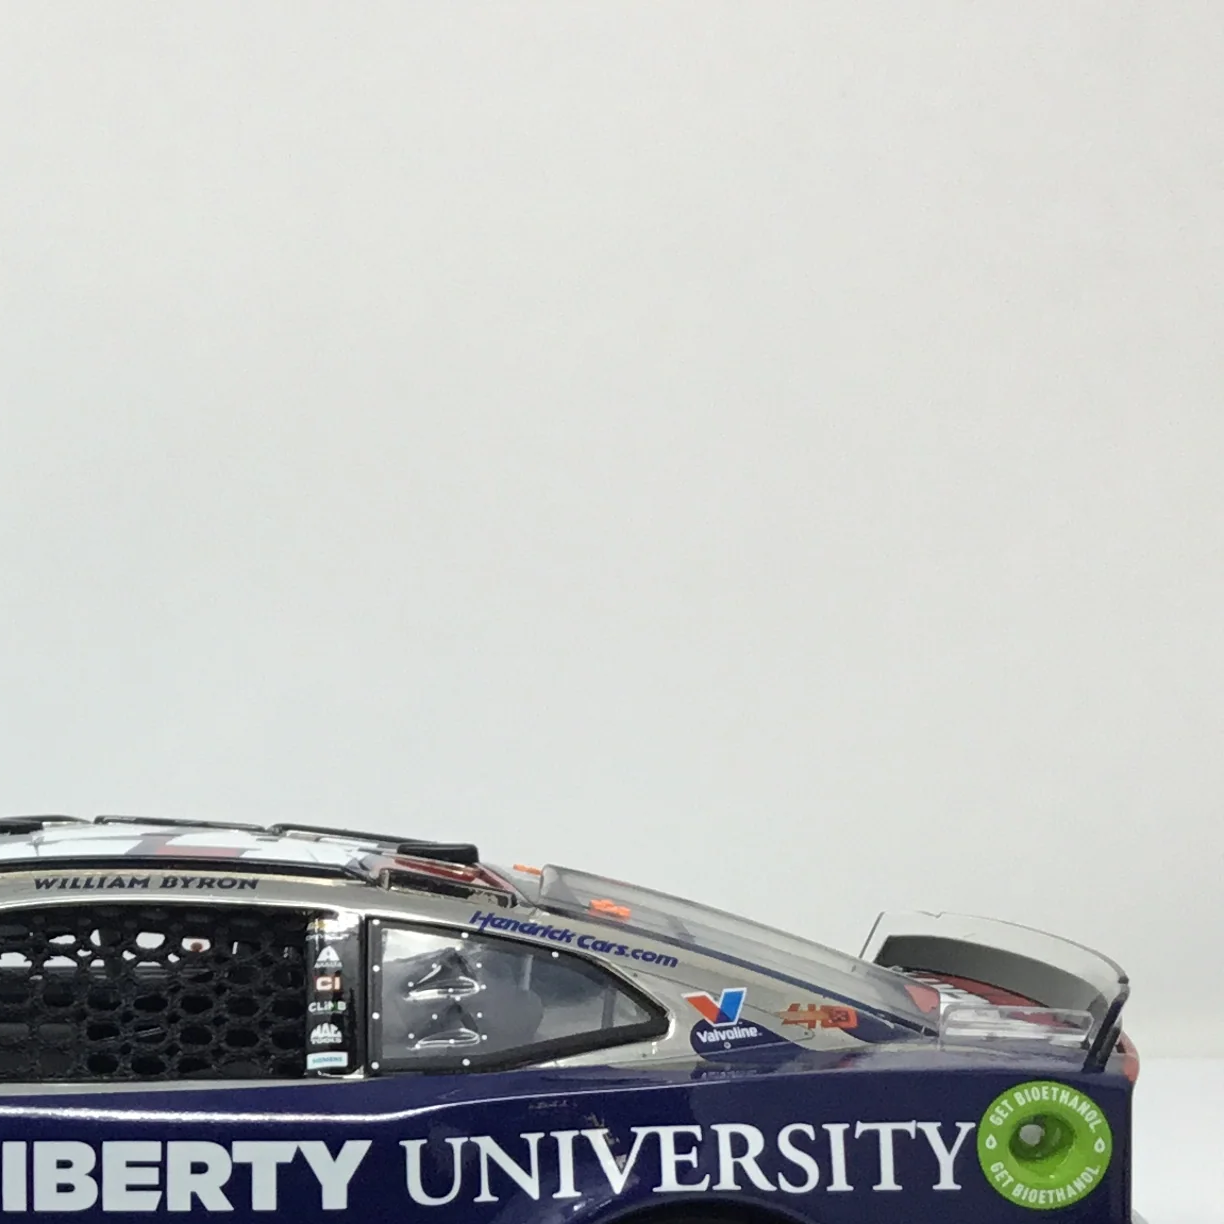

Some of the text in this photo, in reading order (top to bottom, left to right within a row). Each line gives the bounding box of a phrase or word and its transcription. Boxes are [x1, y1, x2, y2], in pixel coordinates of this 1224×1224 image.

[33, 876, 259, 890] WILLIAM BYRON
[695, 1026, 759, 1044] Valvoline
[989, 1085, 1102, 1133] GET BIOETHANOL
[398, 1121, 976, 1207] UNIVERSITY
[990, 1161, 1101, 1205] GET BIOETHANOL
